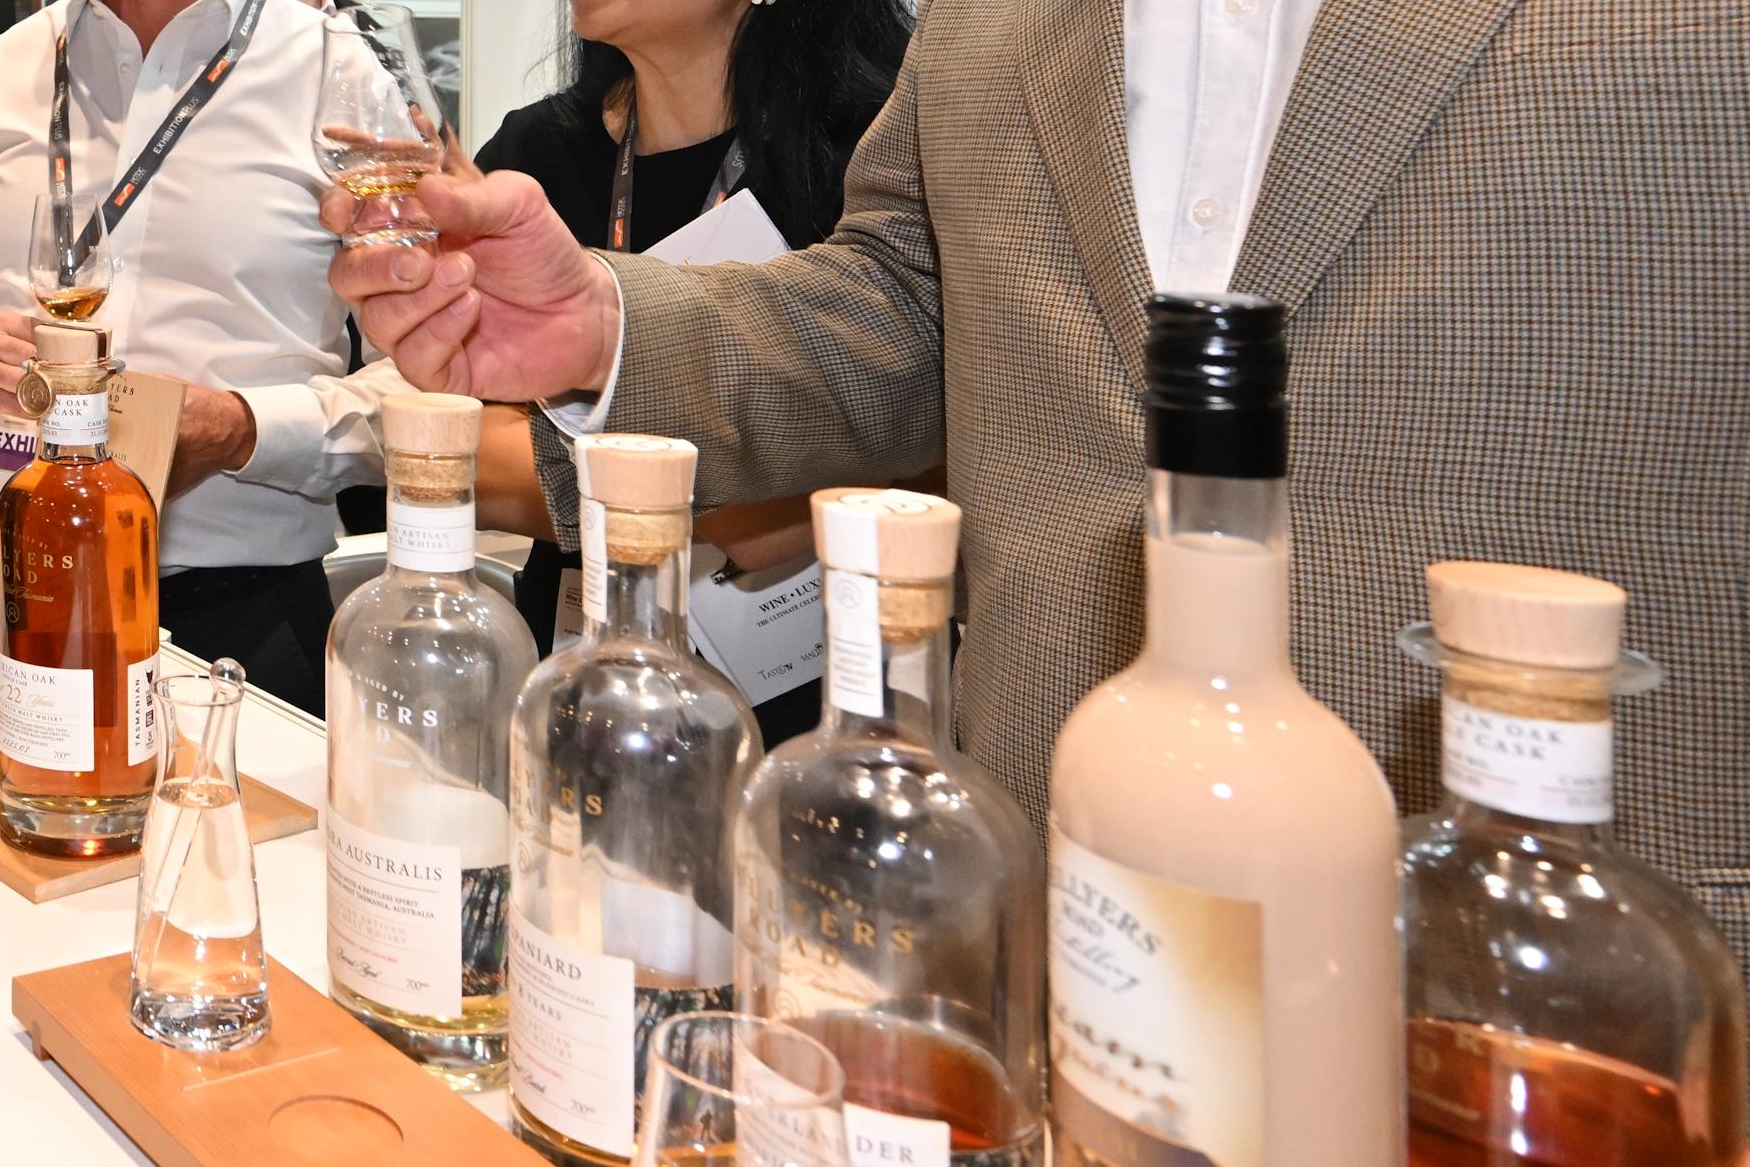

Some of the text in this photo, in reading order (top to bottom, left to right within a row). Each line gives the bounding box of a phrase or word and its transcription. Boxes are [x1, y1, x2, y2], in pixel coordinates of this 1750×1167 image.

[111, 383, 136, 395] YERS
[54, 408, 82, 416] CASK
[66, 399, 89, 407] OAK
[4, 546, 74, 569] LYERS
[4, 564, 37, 584] OAD
[758, 592, 790, 614] WINE
[32, 674, 56, 684] OAK
[7, 684, 21, 704] 22
[358, 695, 438, 727] YERS
[1506, 722, 1563, 744] OAK
[1474, 735, 1547, 760] CASK
[346, 843, 442, 881] AUSTRALIS
